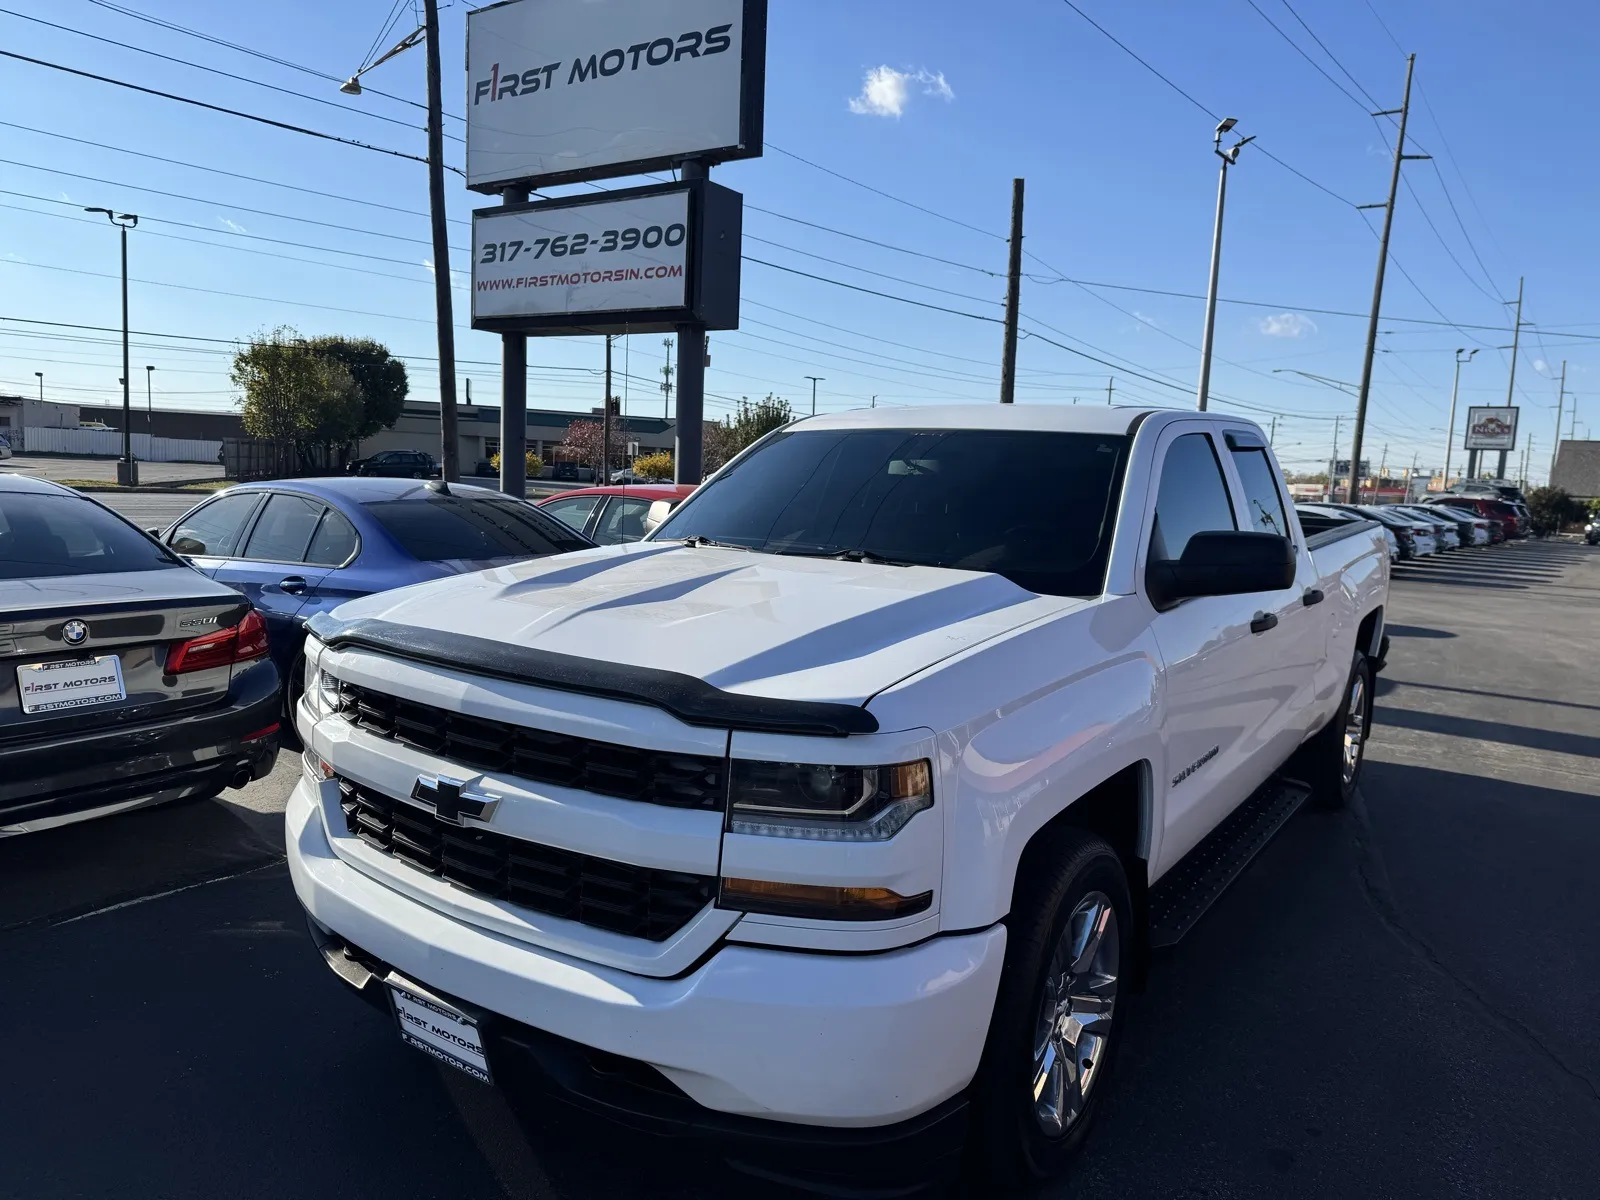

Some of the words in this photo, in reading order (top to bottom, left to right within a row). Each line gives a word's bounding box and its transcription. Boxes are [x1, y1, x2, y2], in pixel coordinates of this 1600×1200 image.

[568, 24, 733, 85] MOTORS
[480, 223, 686, 264] 317-762-3900
[477, 265, 683, 292] WWW.FIRSTMOTORSIN.COM
[65, 660, 95, 668] MOTORS
[63, 676, 116, 688] MOTORS
[431, 1025, 483, 1053] MOTORS
[402, 1034, 490, 1082] FRSTMOTOR.COM
